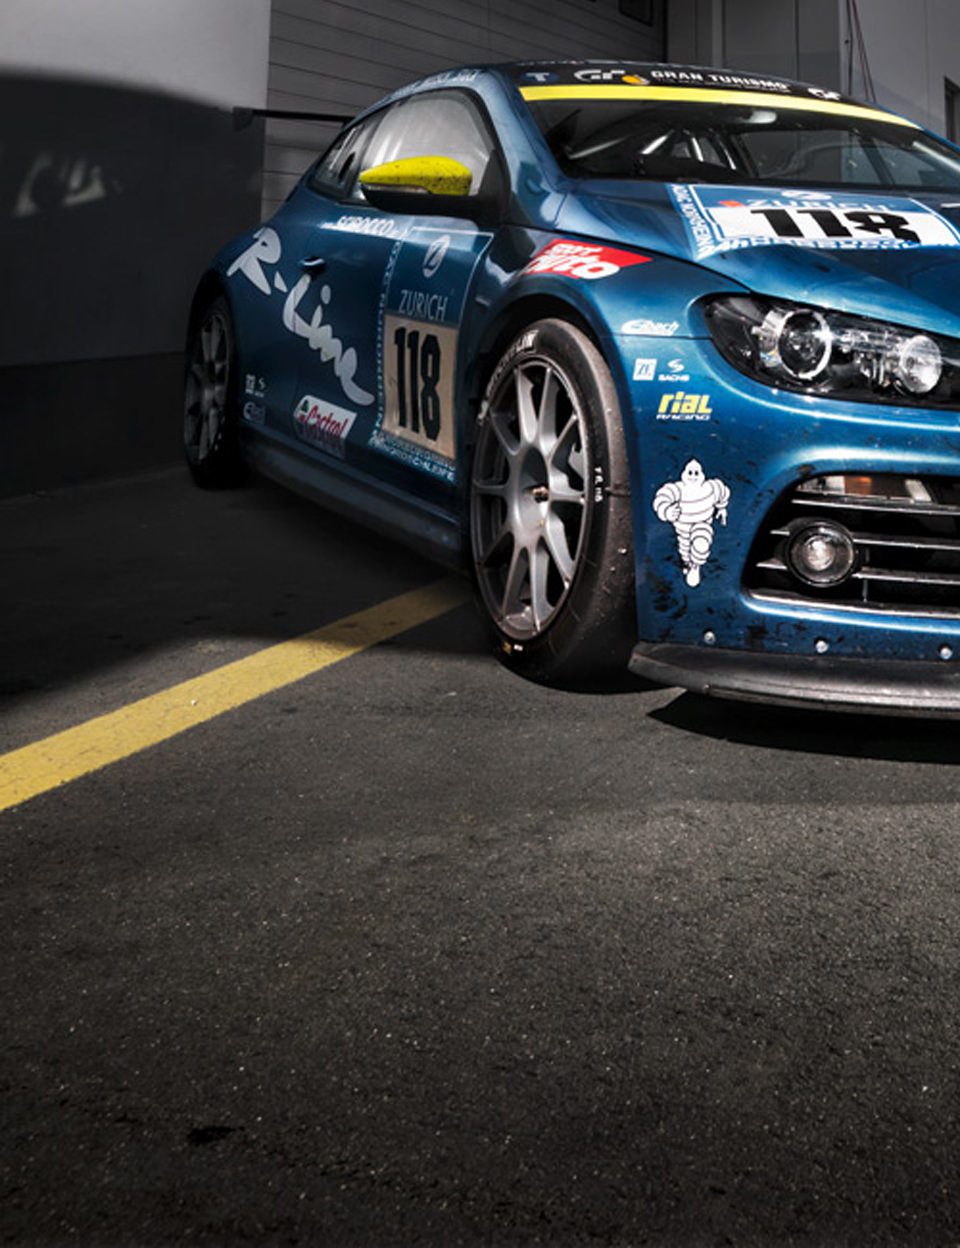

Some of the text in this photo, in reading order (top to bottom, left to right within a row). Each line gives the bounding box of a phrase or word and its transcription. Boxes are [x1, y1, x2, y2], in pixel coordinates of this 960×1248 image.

[650, 70, 703, 82] GRAN
[710, 74, 789, 90] TURISMO
[750, 208, 921, 244] 118
[226, 227, 375, 406] R-Line
[399, 289, 448, 322] ZURICH
[394, 327, 441, 442] 118
